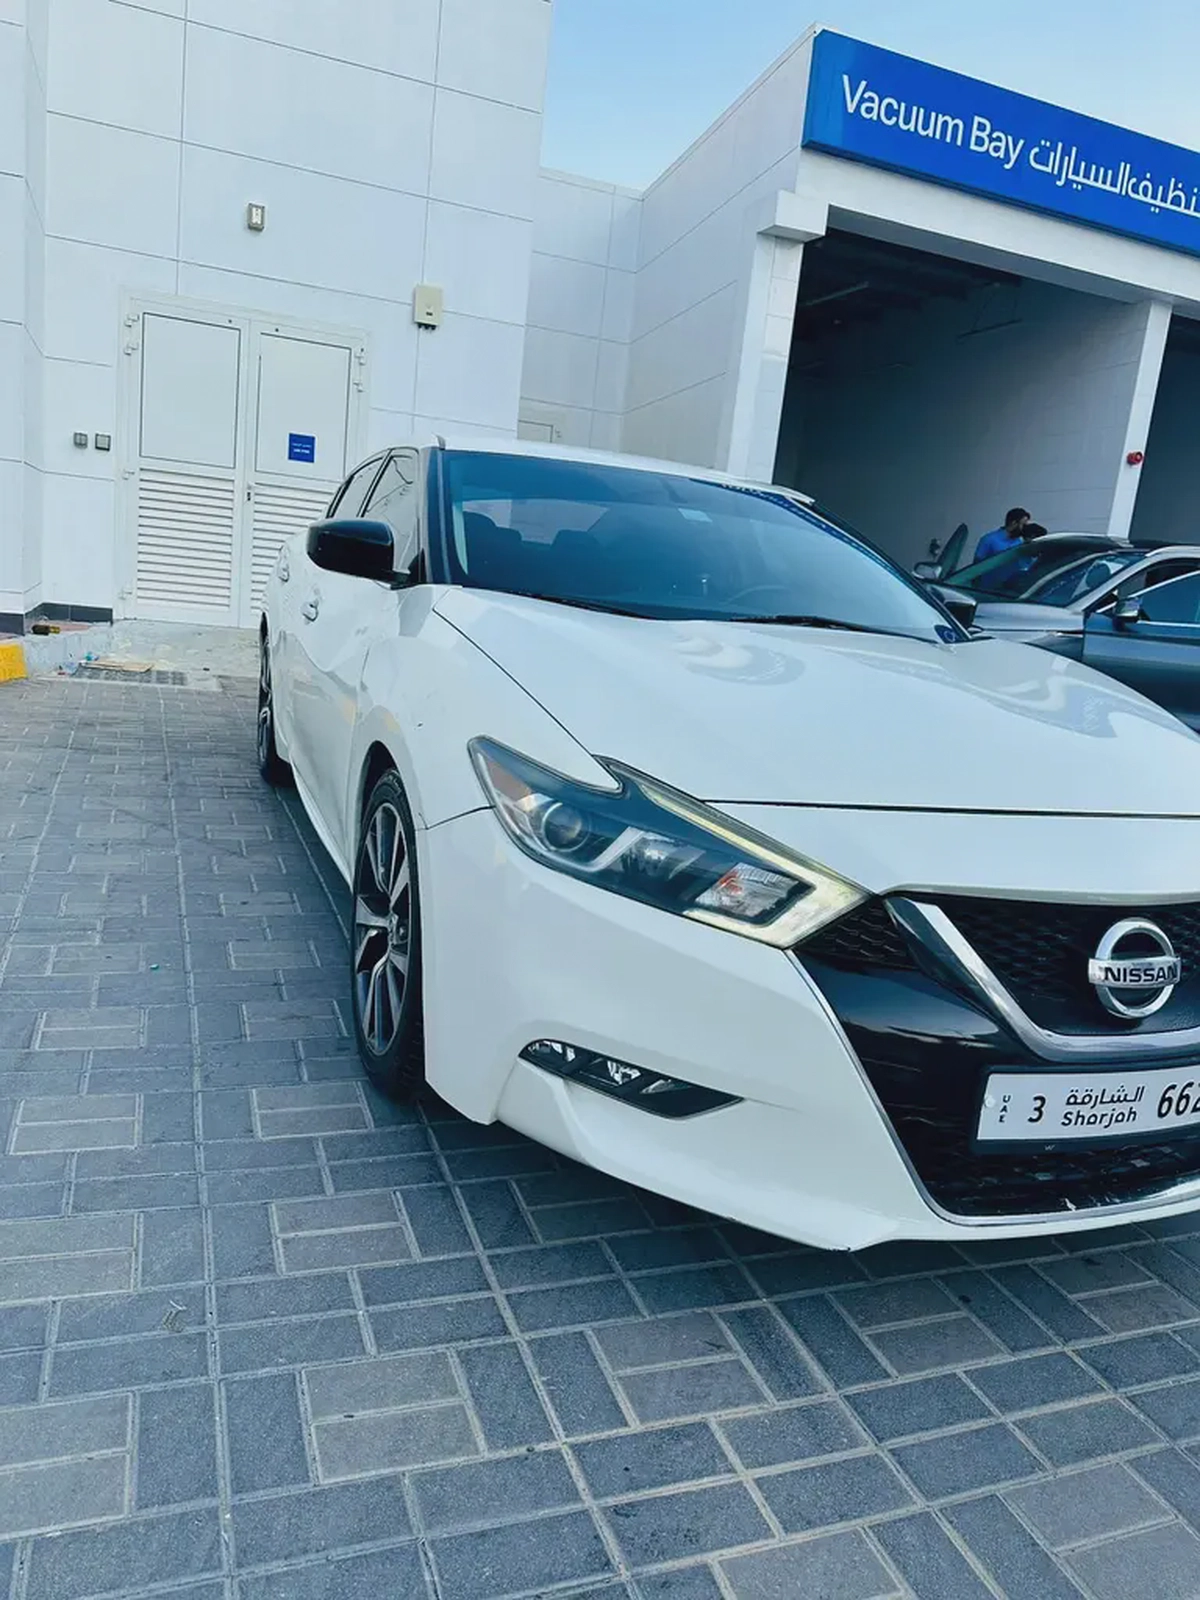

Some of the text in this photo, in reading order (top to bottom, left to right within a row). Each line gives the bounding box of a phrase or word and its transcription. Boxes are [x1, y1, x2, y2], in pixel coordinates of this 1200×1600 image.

[842, 73, 1025, 169] Vacuum Bay
[1127, 172, 1200, 218] نظيف
[1104, 964, 1178, 983] NISSAN
[1027, 1095, 1046, 1123] 3
[1065, 1085, 1145, 1109] الشارقة
[1061, 1106, 1137, 1129] Sharjah
